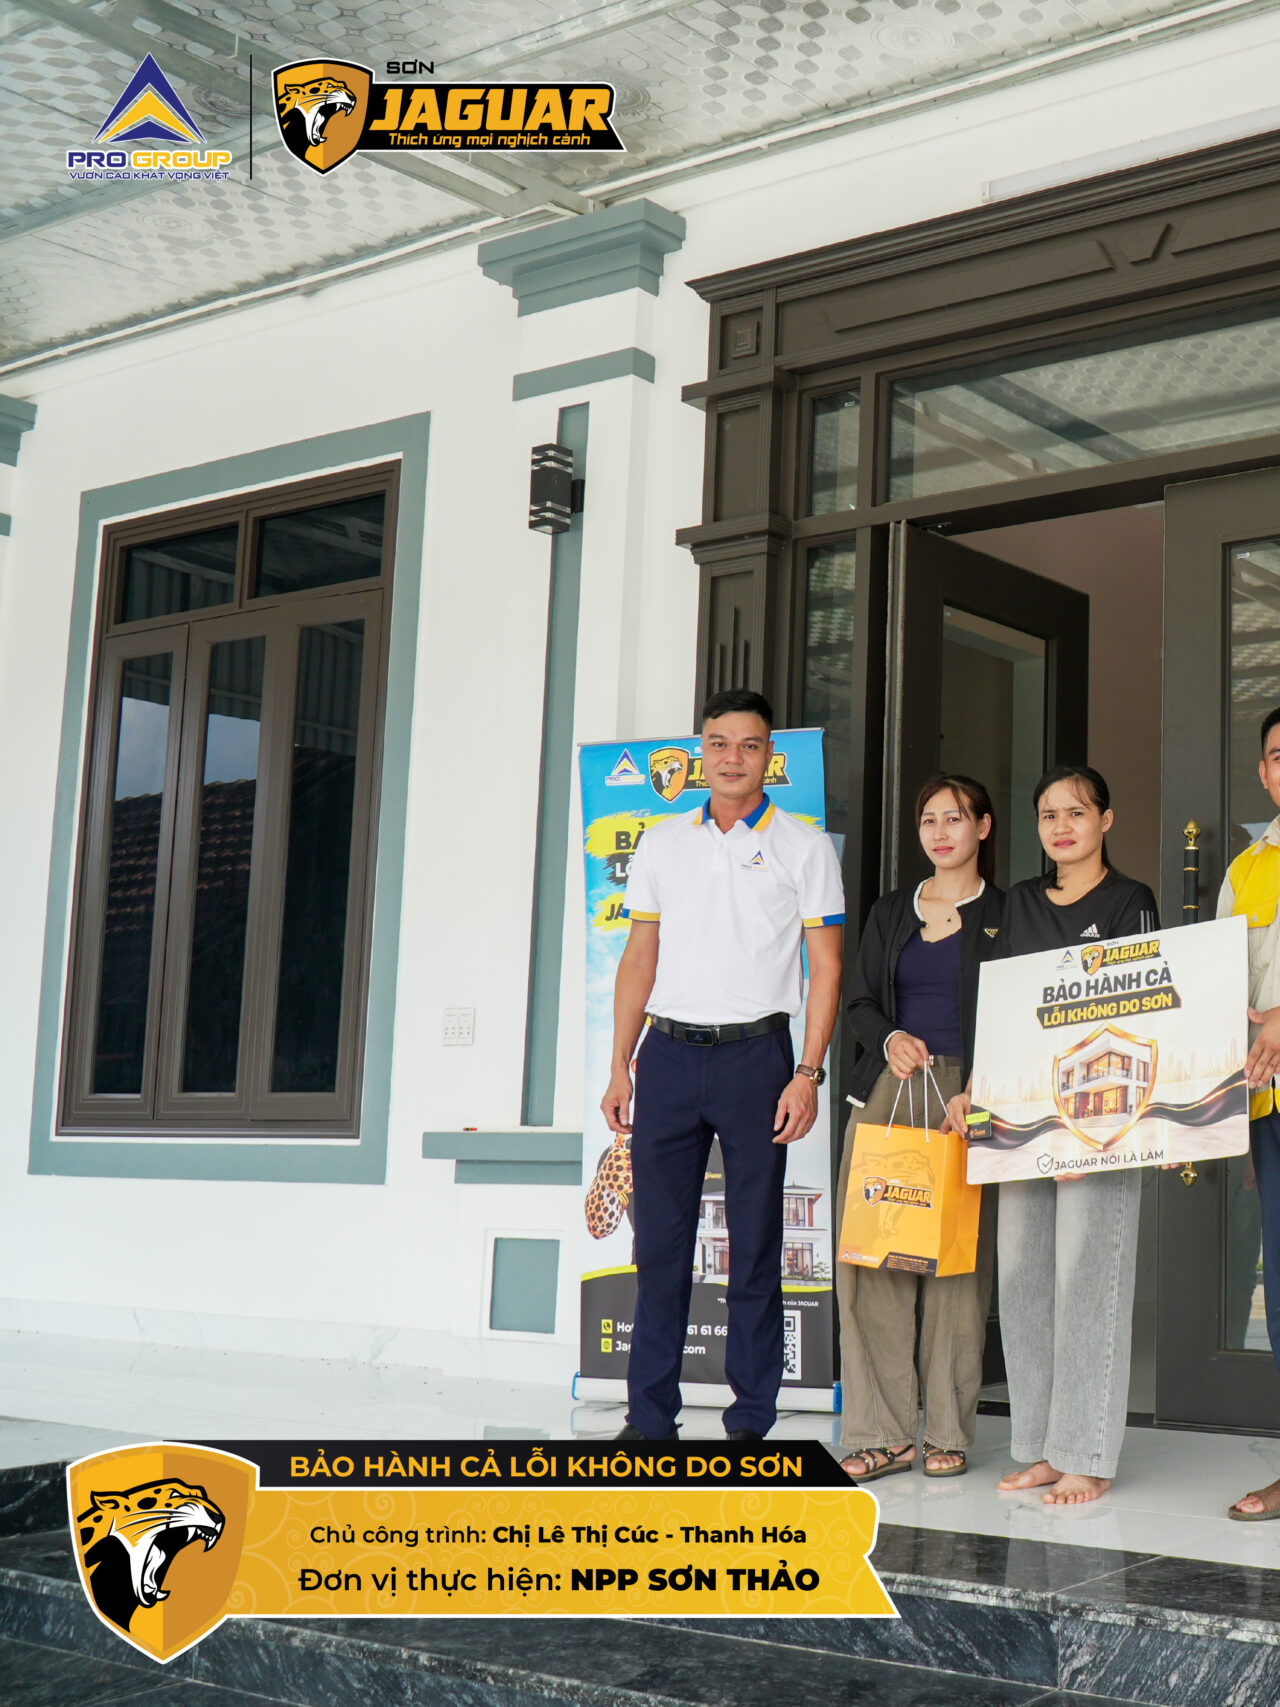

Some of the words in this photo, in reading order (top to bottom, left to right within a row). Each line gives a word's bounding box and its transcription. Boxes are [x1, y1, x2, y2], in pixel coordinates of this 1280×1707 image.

[1103, 940, 1160, 962] JAGUAR
[1042, 978, 1082, 1004] BẢO
[1085, 972, 1142, 997] HÀNH
[1145, 960, 1172, 987] CẢ
[1043, 1005, 1066, 1027] LỖI
[1067, 1002, 1118, 1023] KHÔNG
[1119, 998, 1140, 1015] DO
[1141, 991, 1173, 1011] SƠN
[1054, 1157, 1098, 1171] JAGUAR
[1100, 1153, 1120, 1166] NÓI
[1123, 1150, 1138, 1163] LÀ
[1140, 1149, 1164, 1162] LÀM
[883, 1186, 931, 1203] JAGUAR
[700, 1325, 712, 1336] 61
[714, 1326, 728, 1336] 66
